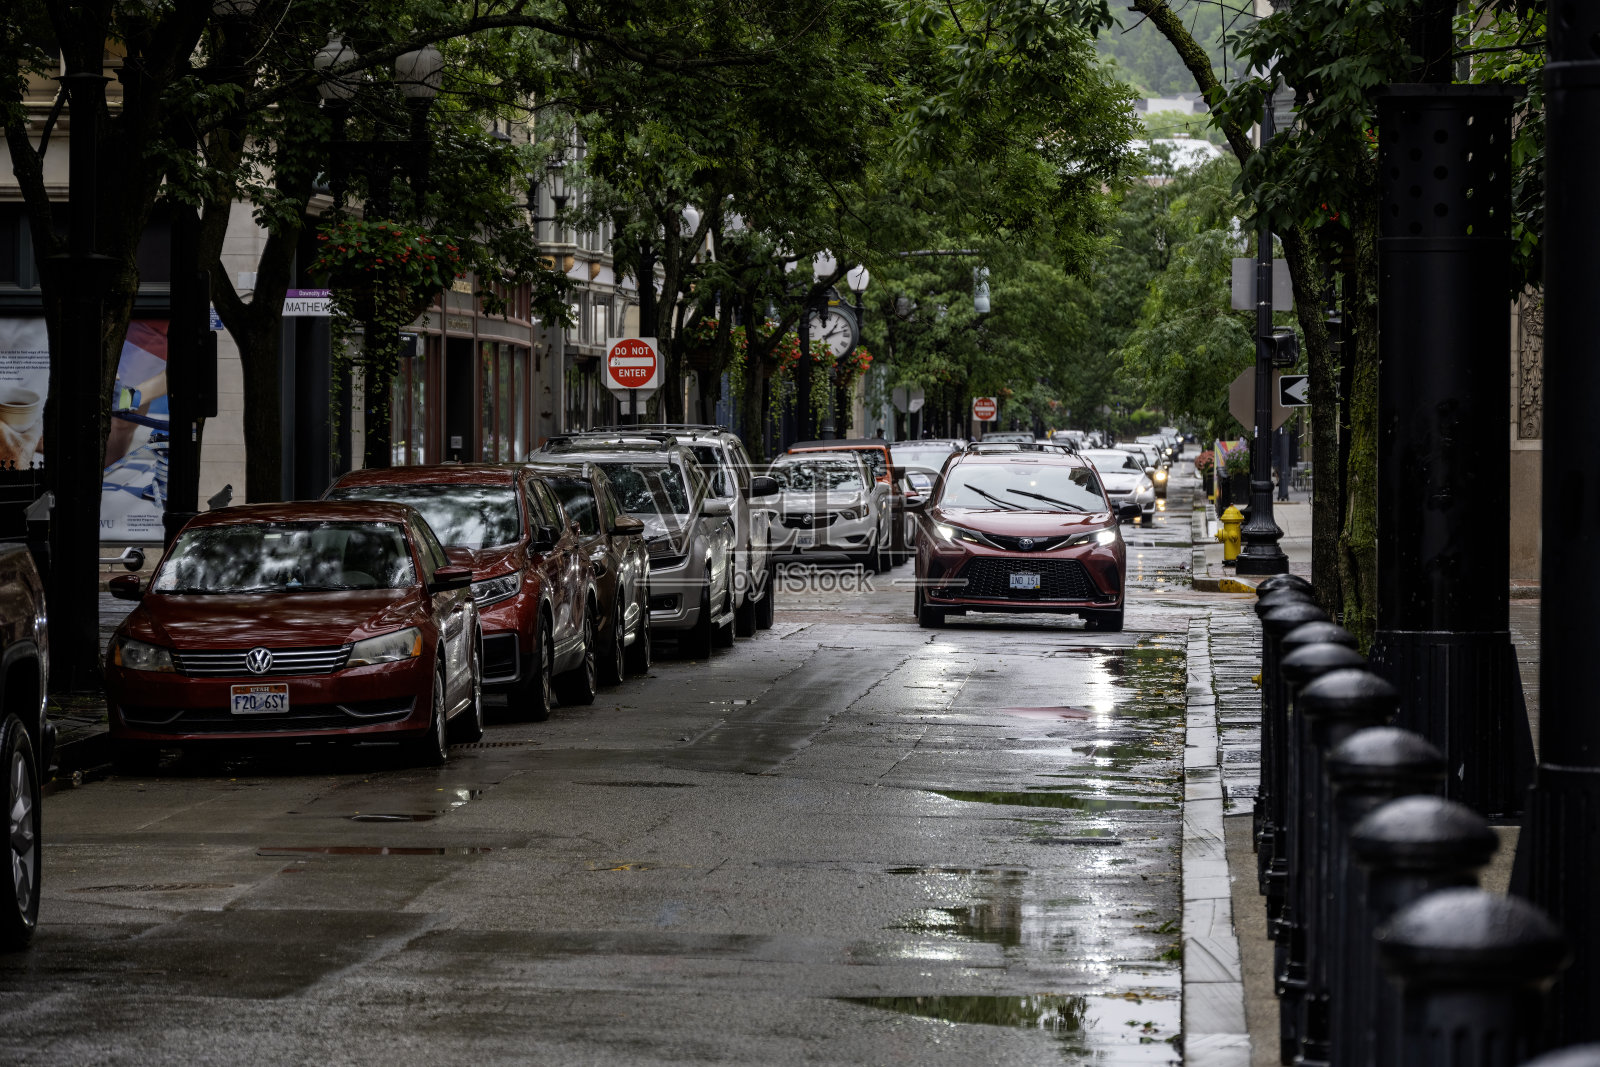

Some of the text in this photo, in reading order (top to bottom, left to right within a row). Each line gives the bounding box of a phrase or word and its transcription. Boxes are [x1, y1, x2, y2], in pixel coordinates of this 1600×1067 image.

[615, 346, 650, 356] DO NOT
[618, 368, 647, 378] ENTER
[235, 694, 285, 710] F20 6SY
